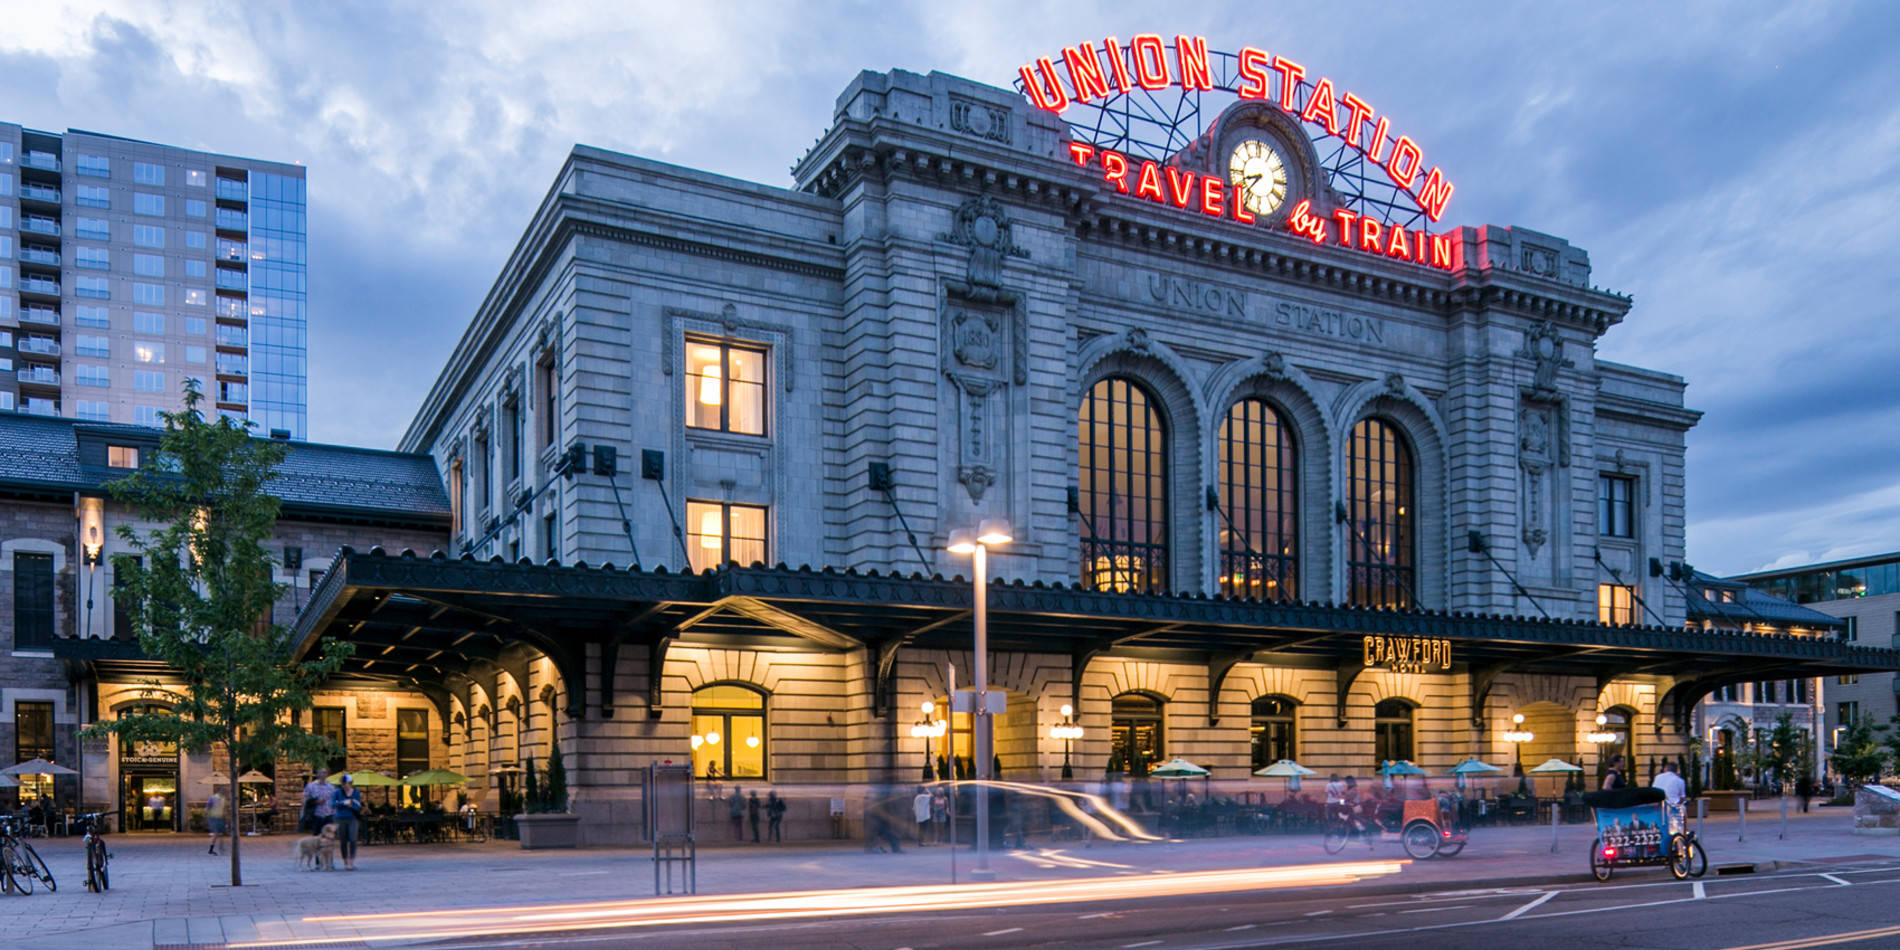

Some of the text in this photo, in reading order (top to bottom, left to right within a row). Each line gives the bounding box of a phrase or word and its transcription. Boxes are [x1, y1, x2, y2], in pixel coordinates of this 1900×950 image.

[1019, 33, 1454, 222] UNION STATION
[1069, 141, 1451, 270] TRAVEL by TRAIN
[1148, 275, 1384, 344] UNION STATION
[1363, 635, 1451, 669] CRAWFORD
[1391, 663, 1427, 674] HOTEL
